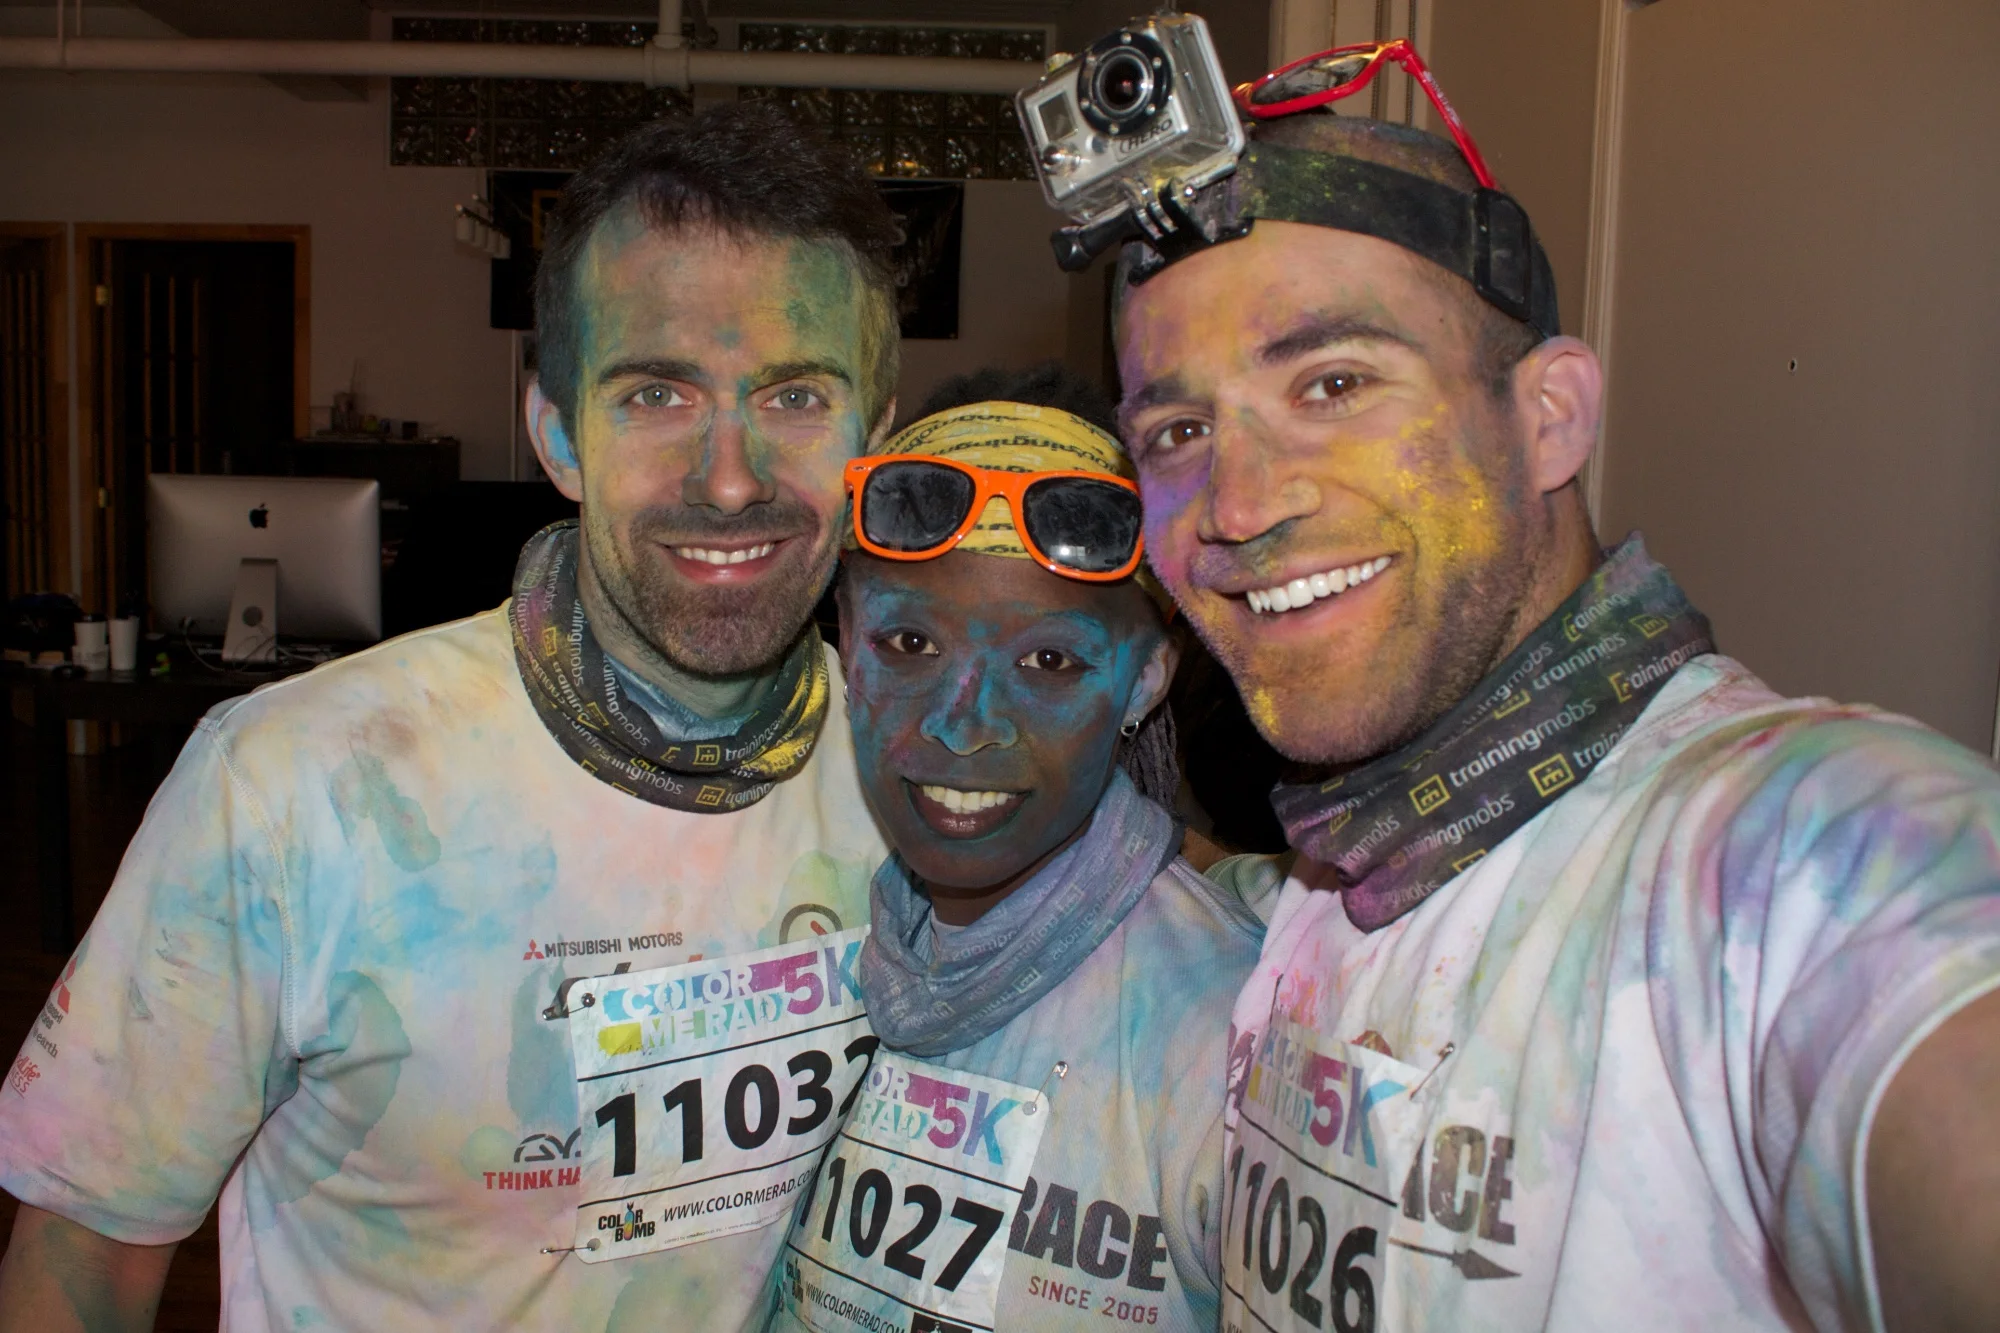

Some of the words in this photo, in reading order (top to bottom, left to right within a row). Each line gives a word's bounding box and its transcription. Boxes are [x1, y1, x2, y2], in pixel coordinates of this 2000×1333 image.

[1450, 697, 1597, 779] trainingmobs
[545, 938, 621, 958] MITSUBISHI
[629, 932, 683, 951] MOTORS
[622, 966, 753, 1019] COLOR
[784, 940, 863, 1016] 5K
[641, 1011, 694, 1050] ME
[926, 1083, 1022, 1166] 5K
[1309, 1052, 1408, 1168] 5K
[482, 1168, 554, 1191] THINK
[1007, 1175, 1168, 1292] RACE
[1028, 1275, 1092, 1310] SINCE
[1101, 1296, 1159, 1326] 2005
